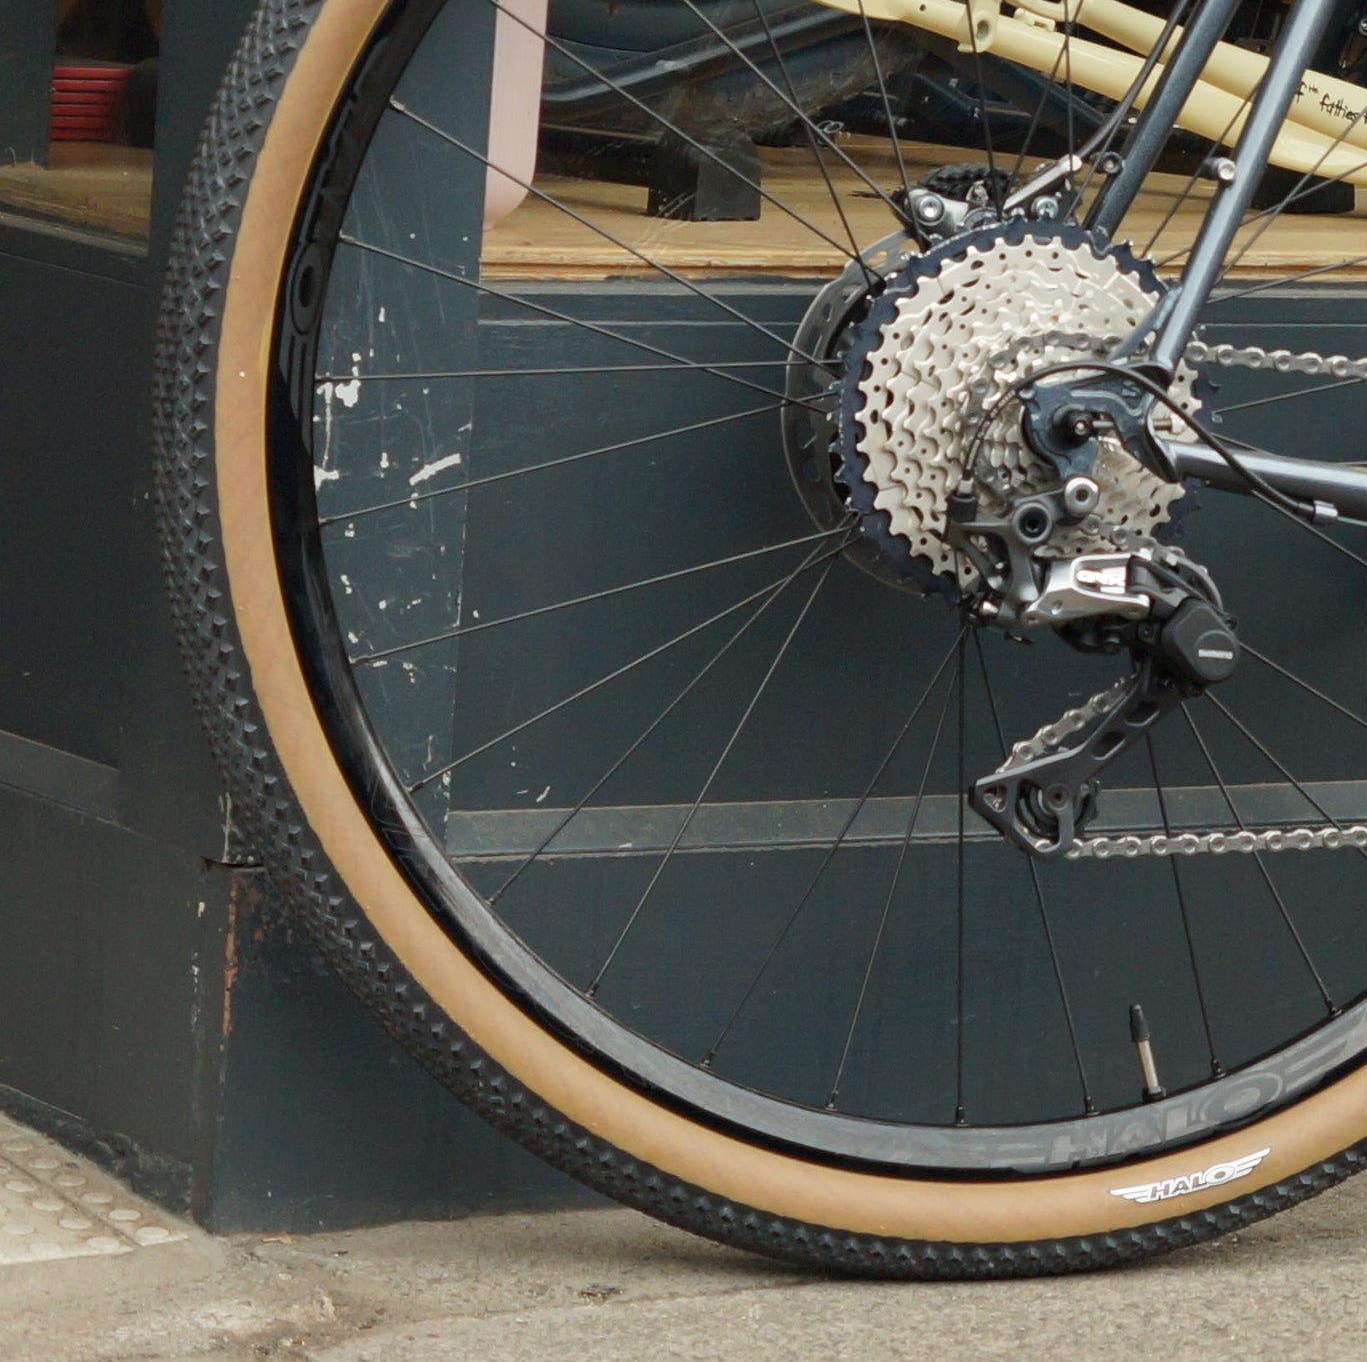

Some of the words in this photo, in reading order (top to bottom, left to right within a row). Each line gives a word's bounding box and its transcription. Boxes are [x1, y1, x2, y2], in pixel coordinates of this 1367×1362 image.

[1319, 93, 1361, 123] fatties
[1049, 1072, 1284, 1164] HALO
[1149, 1163, 1238, 1204] HALO
